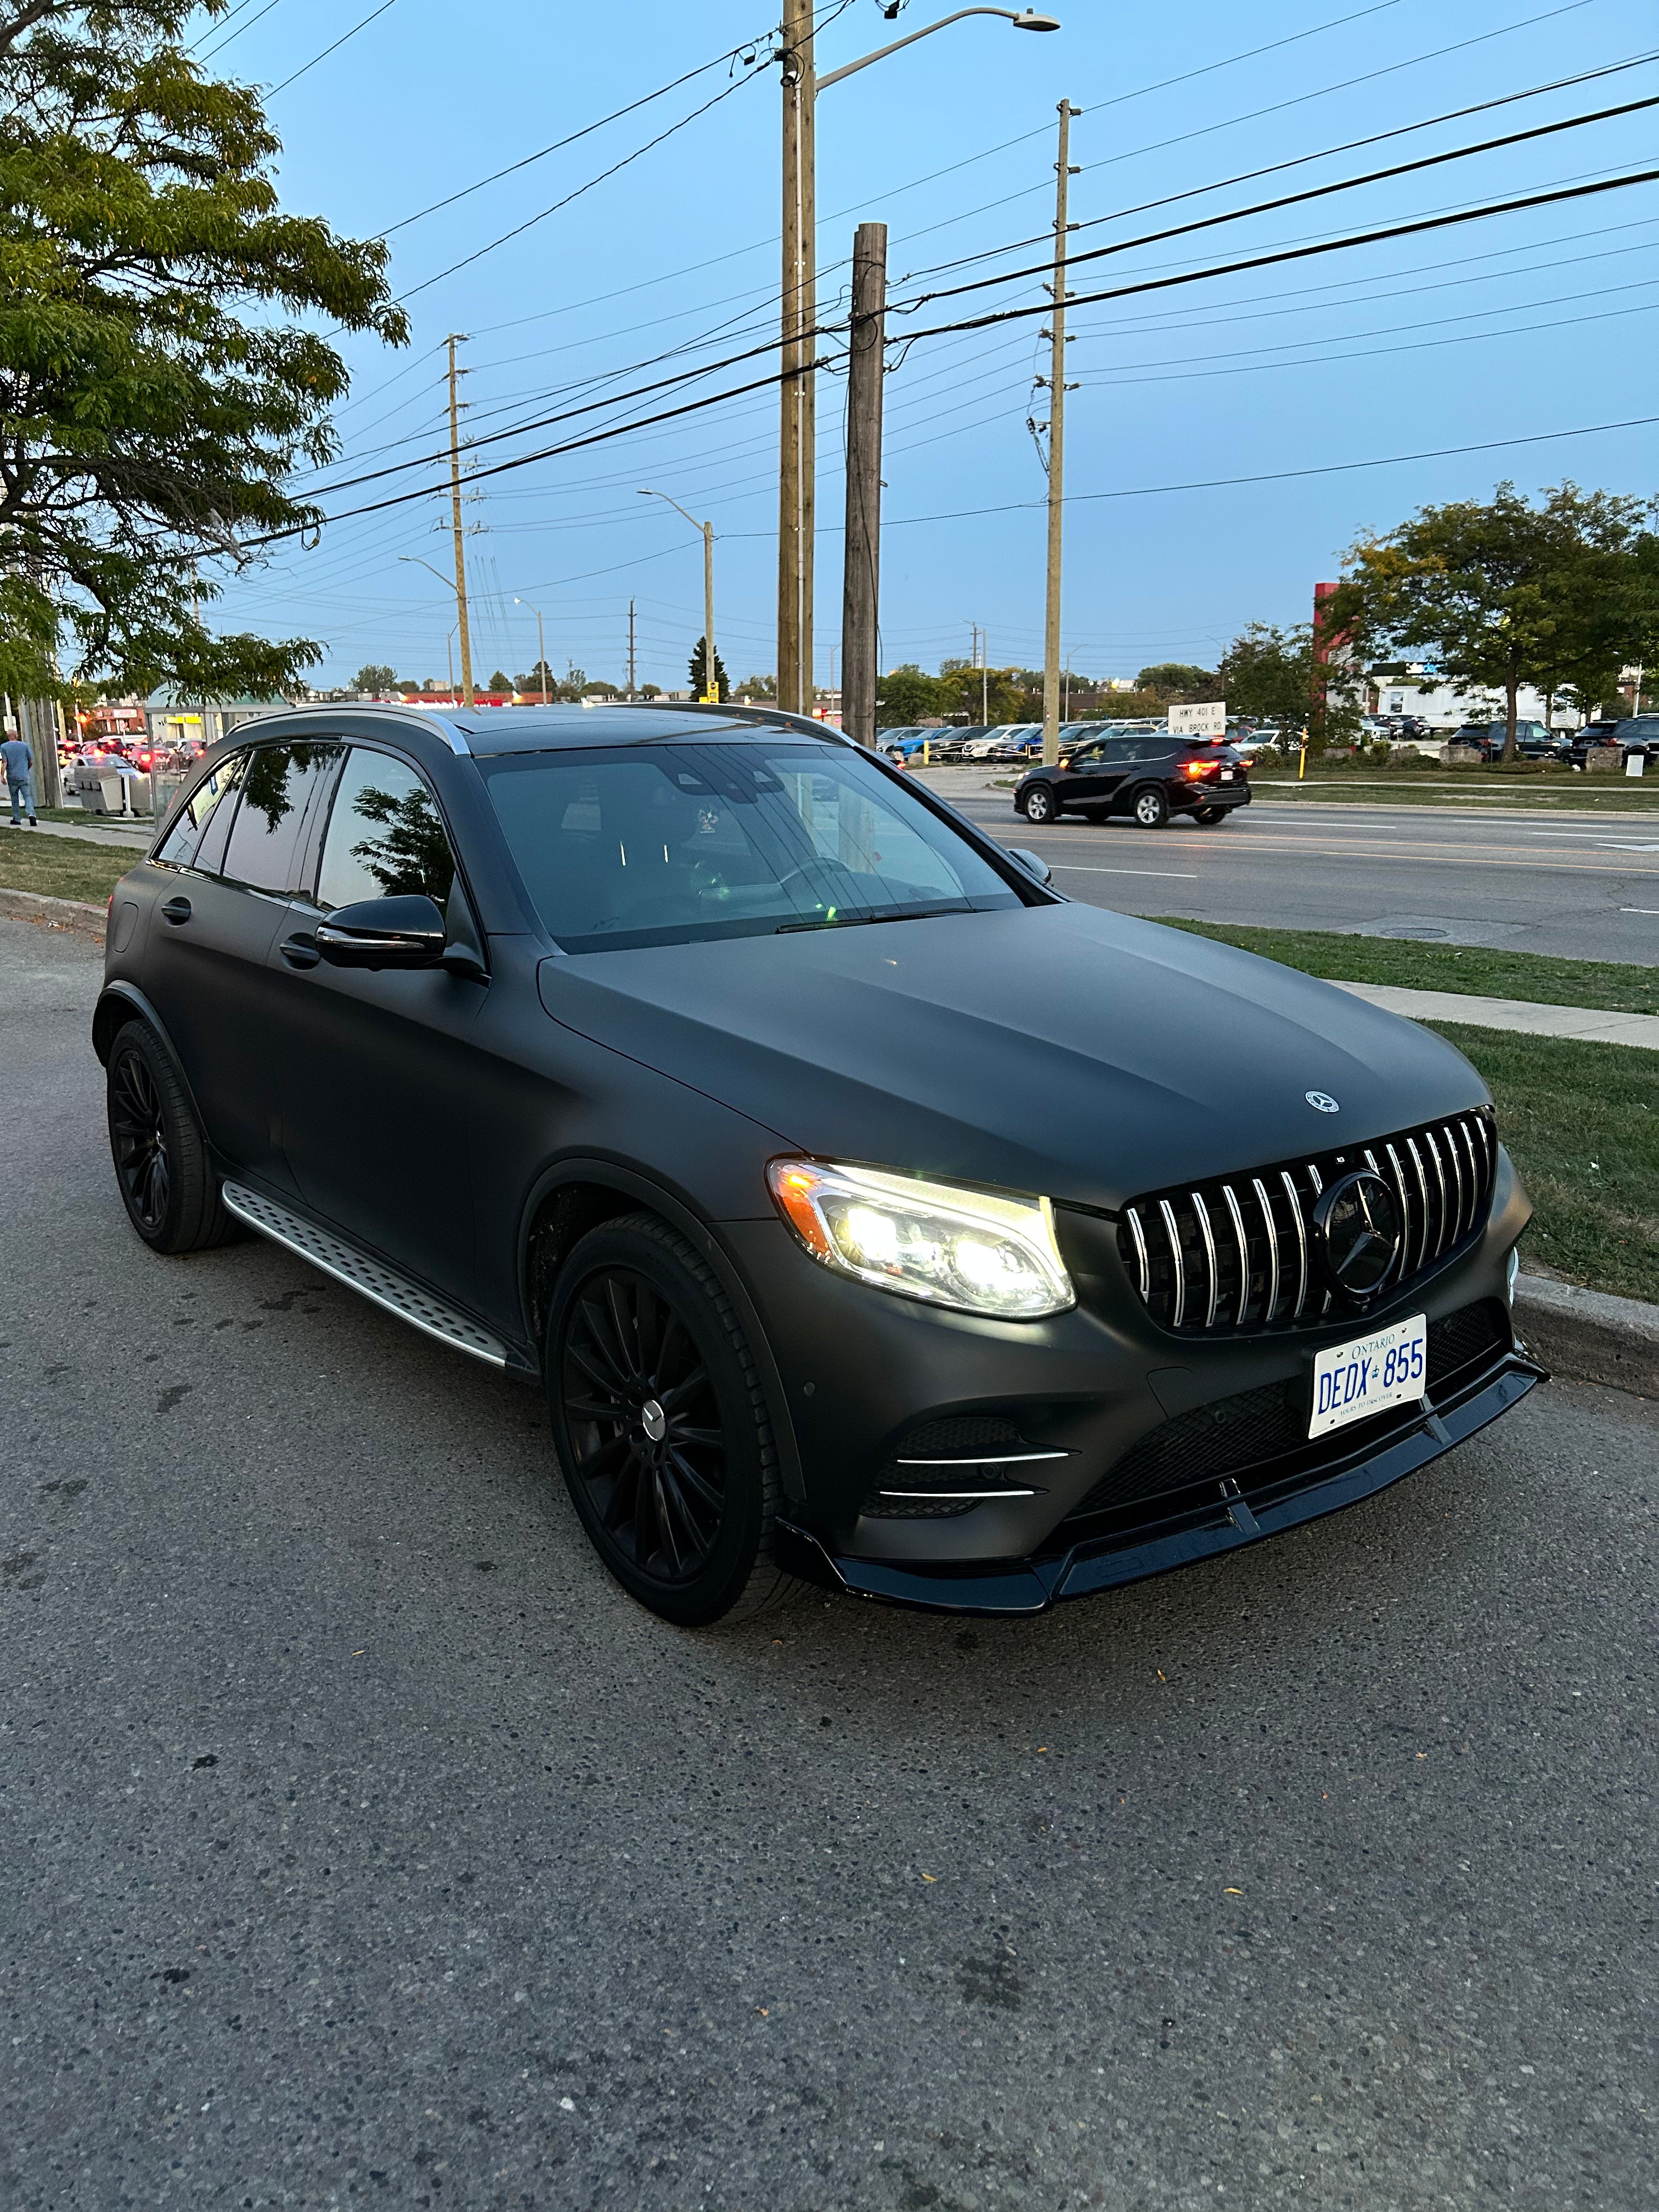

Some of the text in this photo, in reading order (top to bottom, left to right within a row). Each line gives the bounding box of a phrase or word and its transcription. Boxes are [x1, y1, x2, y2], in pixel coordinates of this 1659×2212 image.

[1180, 707, 1215, 718] HWY 401 E
[1189, 723, 1209, 732] BROCK
[1352, 1334, 1395, 1359] ONTARIO
[1318, 1338, 1423, 1415] DEDX 855
[1340, 1406, 1357, 1415] YOURS
[1367, 1392, 1393, 1405] DISCOVER
